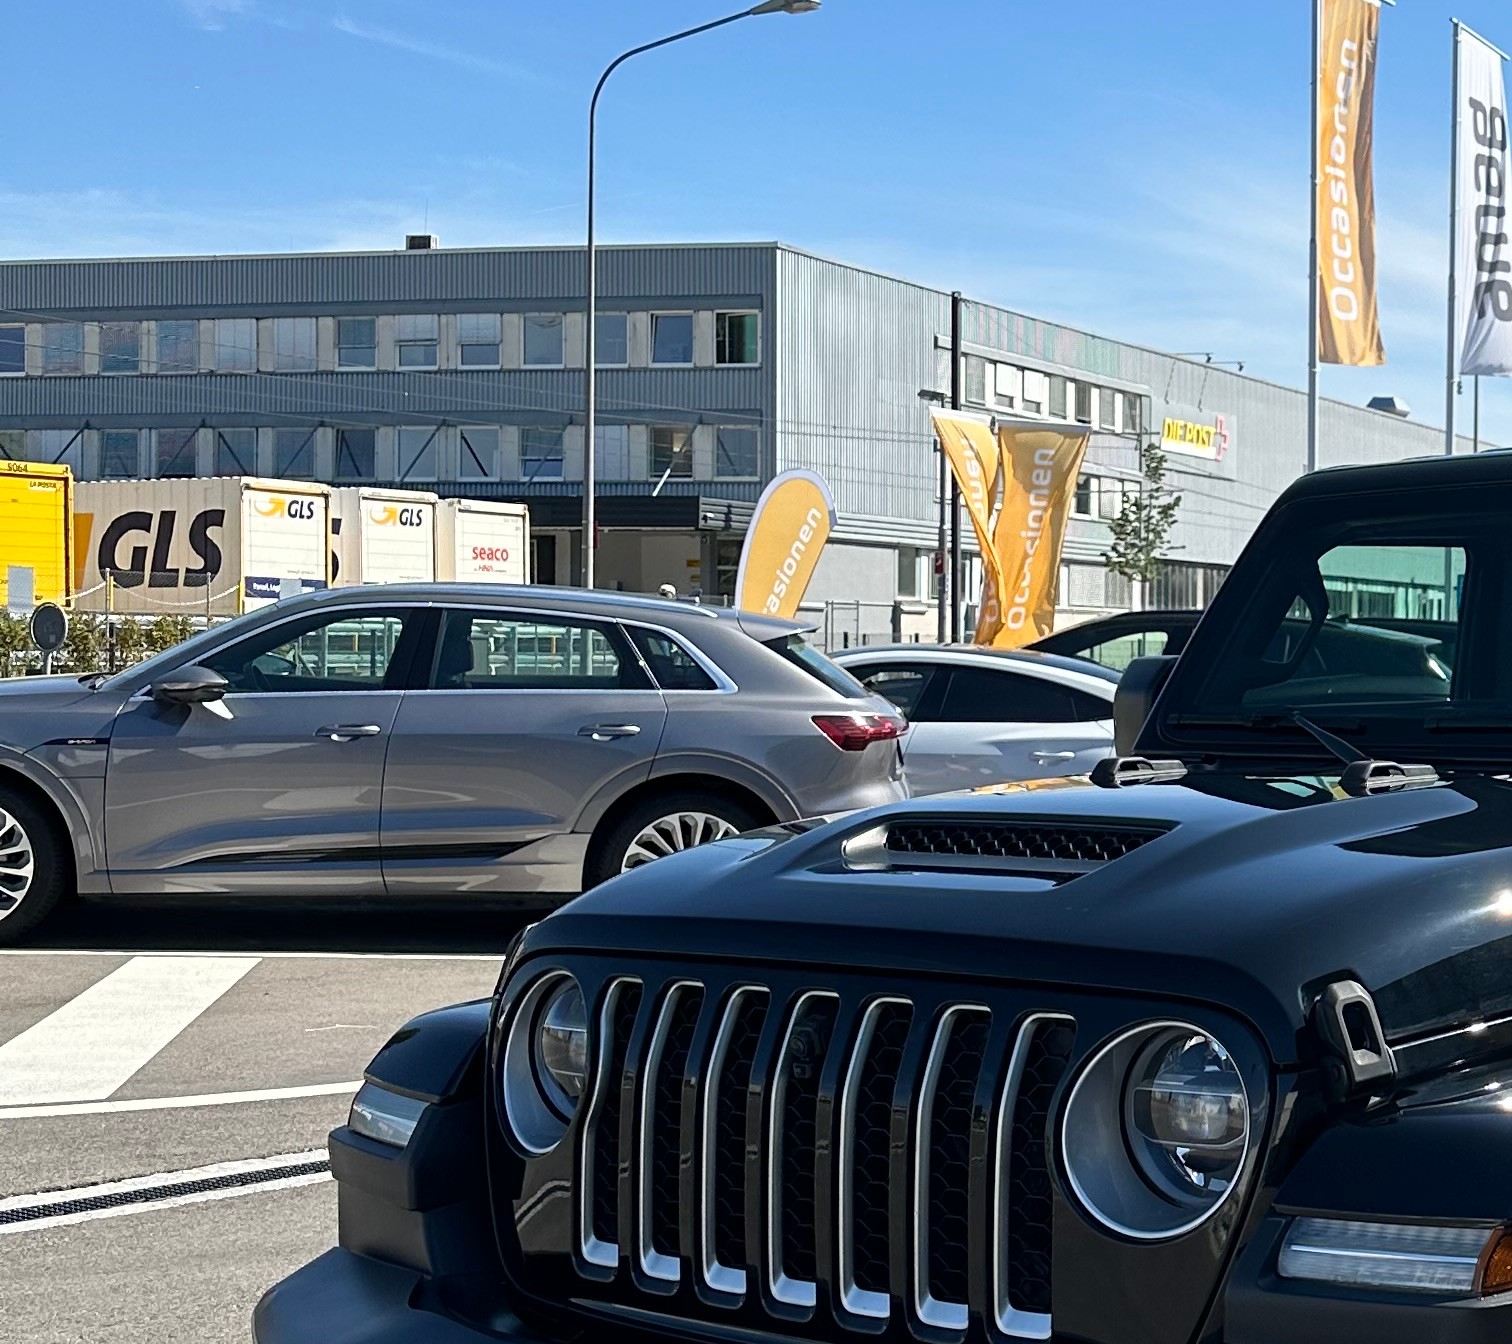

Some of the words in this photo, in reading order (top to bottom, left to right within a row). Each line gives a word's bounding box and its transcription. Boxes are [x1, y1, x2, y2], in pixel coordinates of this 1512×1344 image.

[1163, 417, 1185, 444] DIE
[1185, 421, 1216, 448] POST
[287, 499, 315, 520] GLS
[399, 508, 423, 527] GLS
[98, 508, 226, 588] GLS
[472, 546, 509, 562] seaco
[761, 506, 822, 615] asionen
